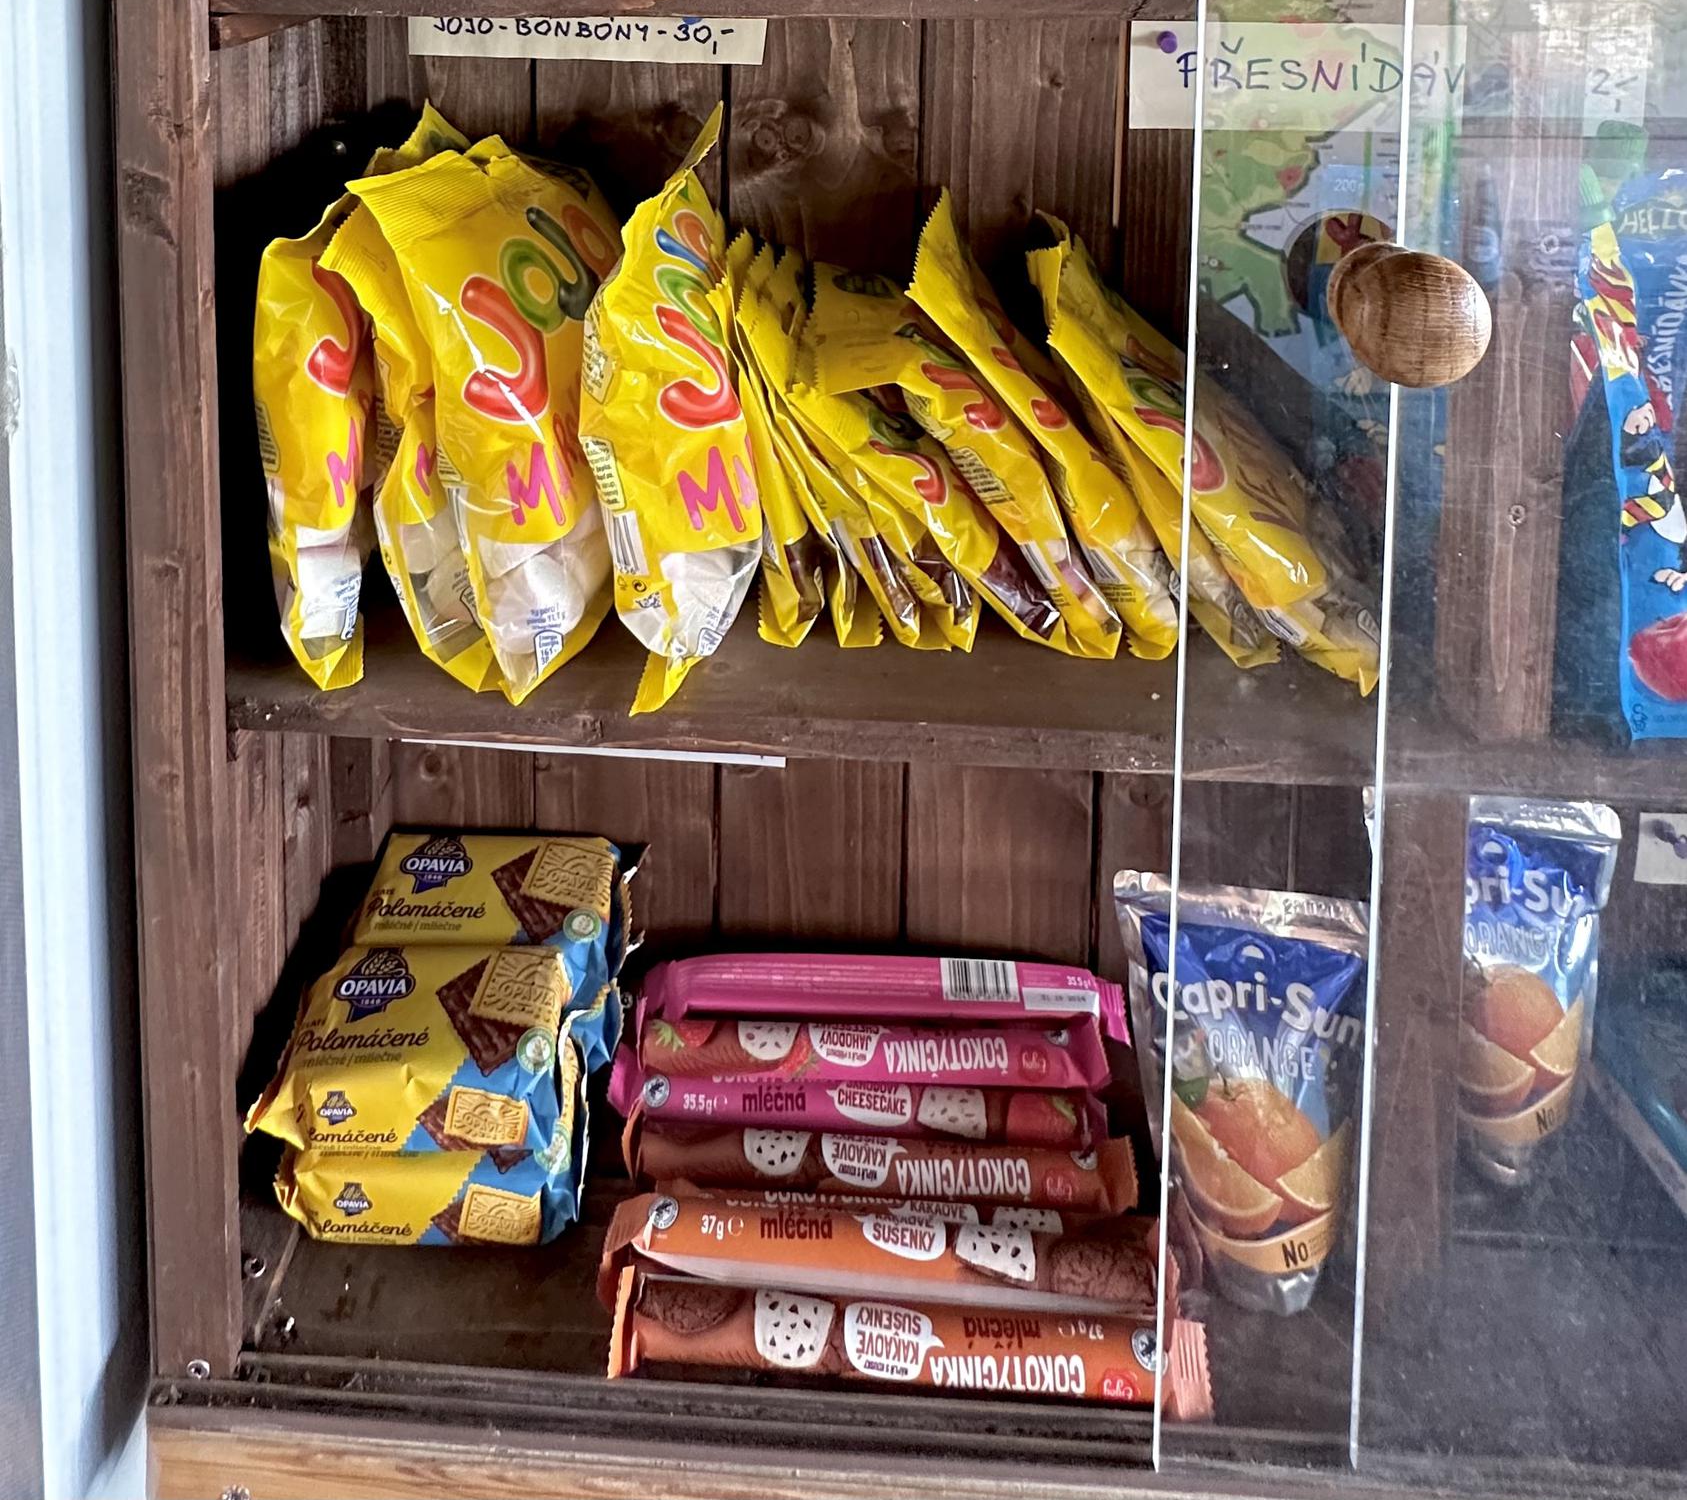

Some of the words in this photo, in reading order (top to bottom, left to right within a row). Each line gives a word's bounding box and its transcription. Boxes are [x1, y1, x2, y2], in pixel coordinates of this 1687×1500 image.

[405, 857, 465, 873] OPAVIA
[341, 979, 407, 996] OPAVIA
[1152, 971, 1361, 1047] Capri-Sun
[296, 1027, 430, 1054] Polomáčené
[819, 1031, 872, 1051] JAHODOVÝ
[883, 1036, 1010, 1078] ČOKOTYČINKA
[1208, 1028, 1317, 1082] ORANGE
[320, 1108, 353, 1118] OPAVIA
[742, 1085, 806, 1113] mléčná
[837, 1087, 908, 1117] CHEESECAKE
[831, 1141, 887, 1168] KAKAOVÉ
[336, 1200, 370, 1209] OPAVIA
[856, 1306, 921, 1336] SUŠENKY
[963, 1316, 1041, 1350] mléčná
[856, 1330, 919, 1365] KAKAOVÉ
